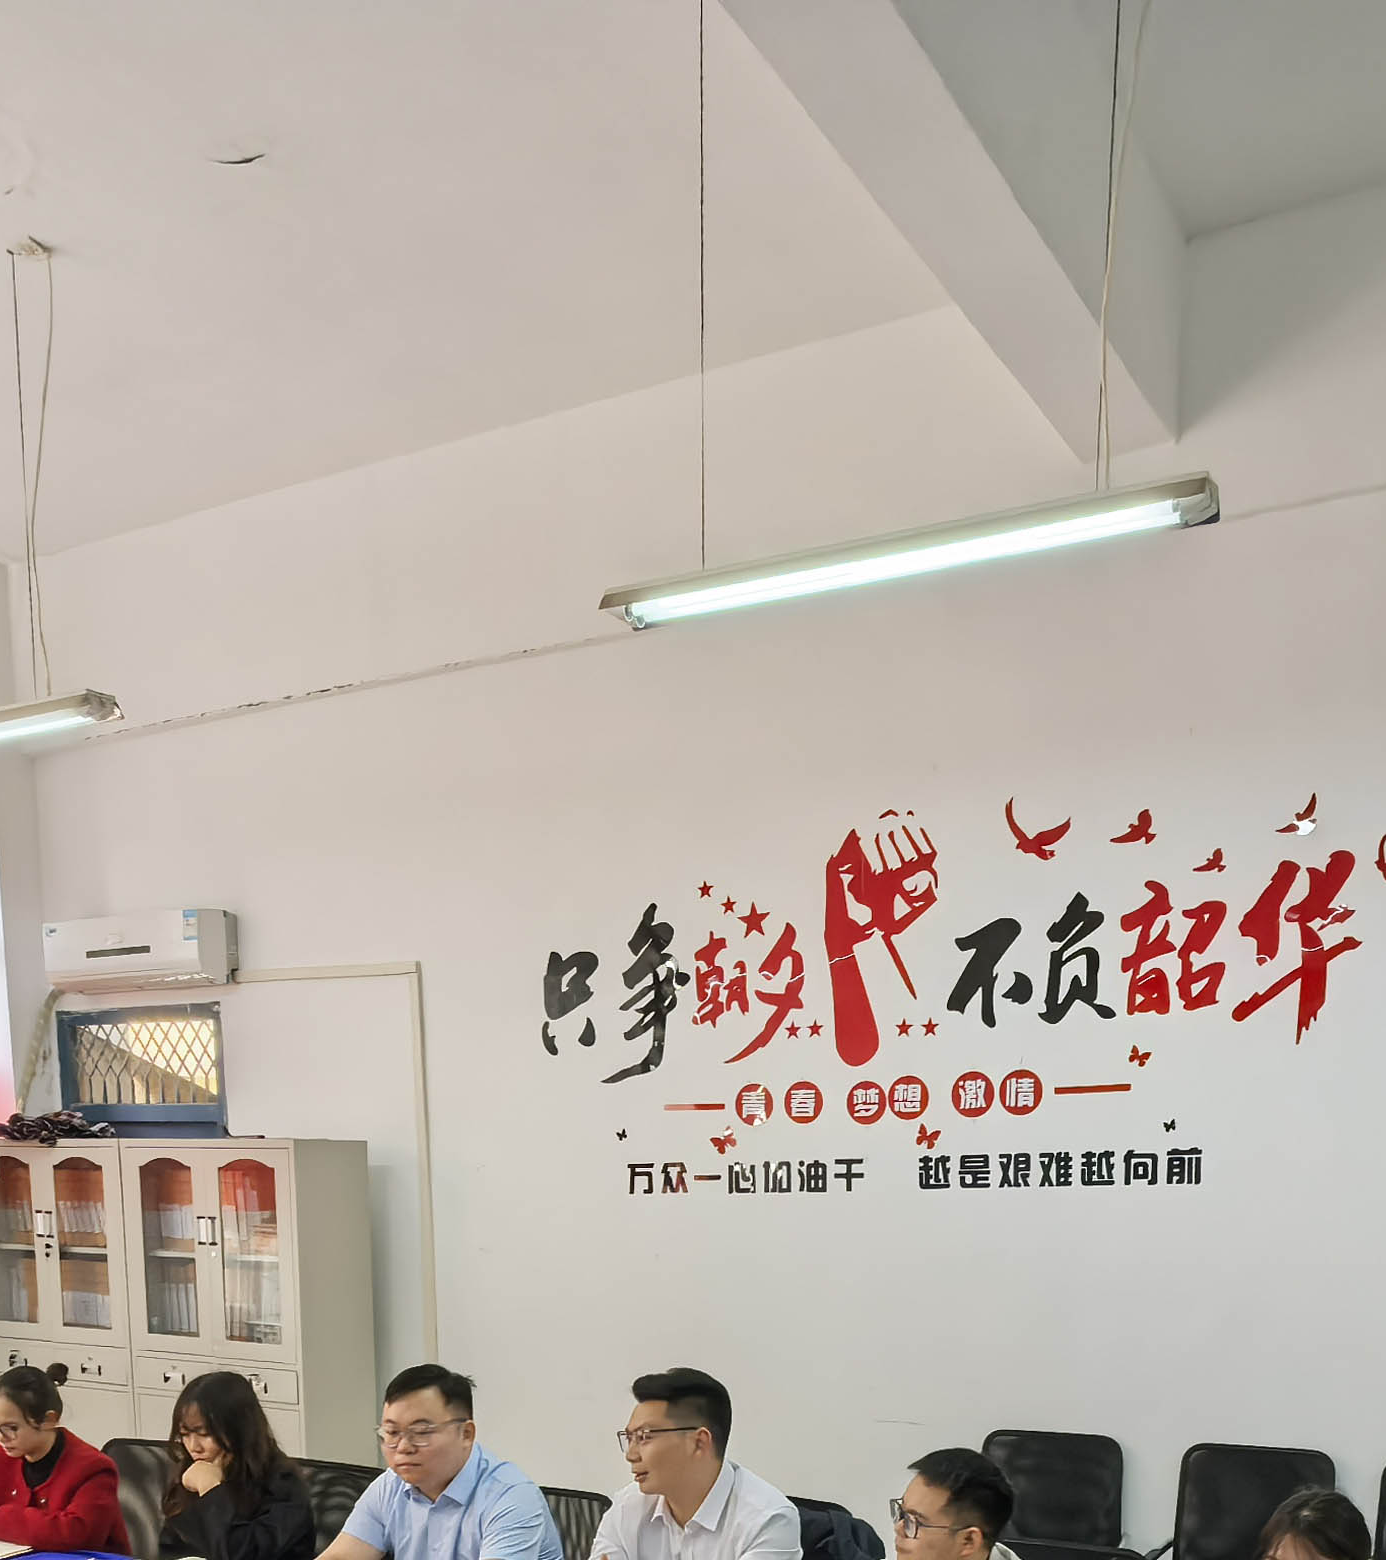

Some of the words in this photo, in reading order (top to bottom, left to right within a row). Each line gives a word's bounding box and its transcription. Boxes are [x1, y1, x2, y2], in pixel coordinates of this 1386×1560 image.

[540, 902, 806, 1085] 只争朝夕
[947, 850, 1363, 1046] 不负韶华
[737, 1083, 822, 1125] 青春
[848, 1080, 928, 1123] 梦想
[953, 1072, 1041, 1116] 激情
[626, 1157, 867, 1195] 万众一心加油干
[917, 1146, 1204, 1192] 越是艰难越向前
